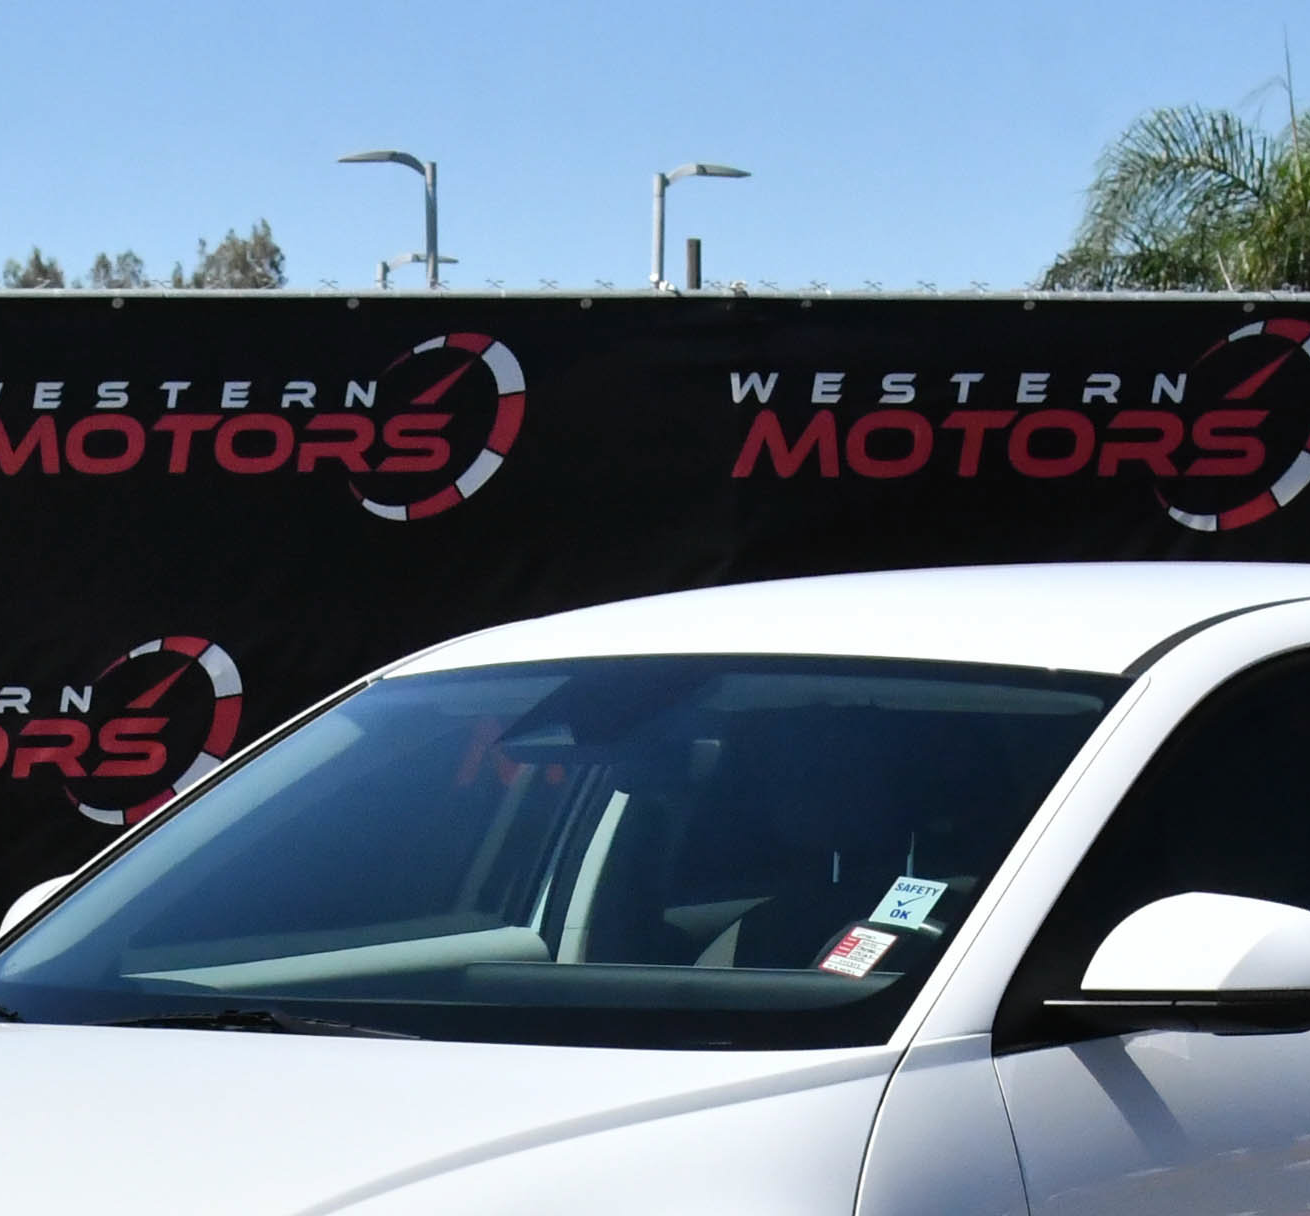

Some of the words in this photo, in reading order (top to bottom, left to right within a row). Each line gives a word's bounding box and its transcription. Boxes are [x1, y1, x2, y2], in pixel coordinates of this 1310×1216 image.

[731, 373, 1187, 403] WESTERN
[731, 410, 1268, 478] MOTORS
[895, 883, 940, 896] SAFETY
[890, 909, 911, 919] OK
